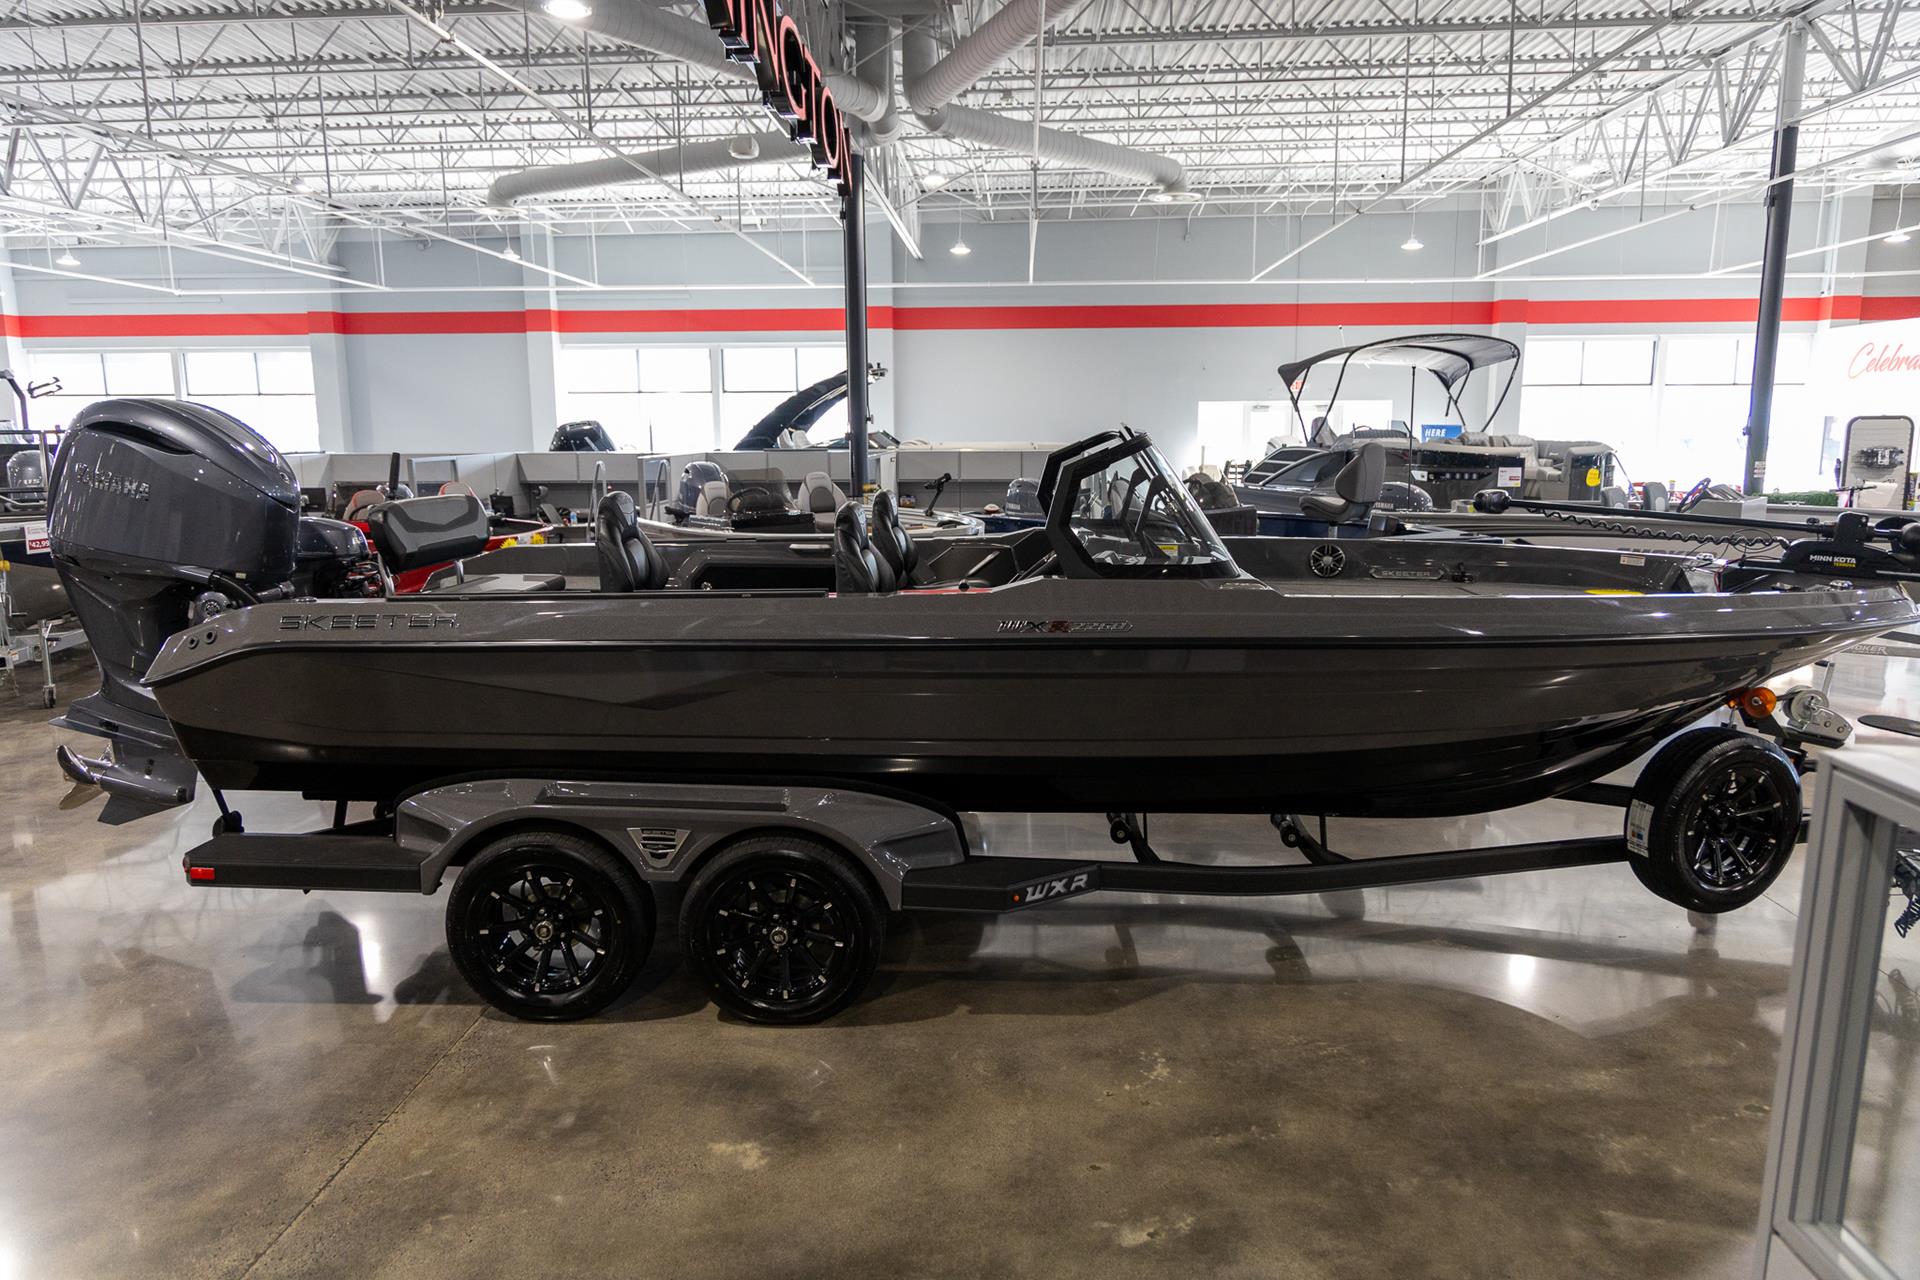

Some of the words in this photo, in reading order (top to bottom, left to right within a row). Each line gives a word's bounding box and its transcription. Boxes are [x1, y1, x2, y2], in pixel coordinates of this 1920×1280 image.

[1425, 429, 1446, 437] HERE
[30, 540, 50, 548] $42,99
[1810, 554, 1832, 562] MINN
[1834, 556, 1856, 564] KOTA
[279, 612, 457, 631] SKEETER
[1024, 873, 1089, 903] WXR
